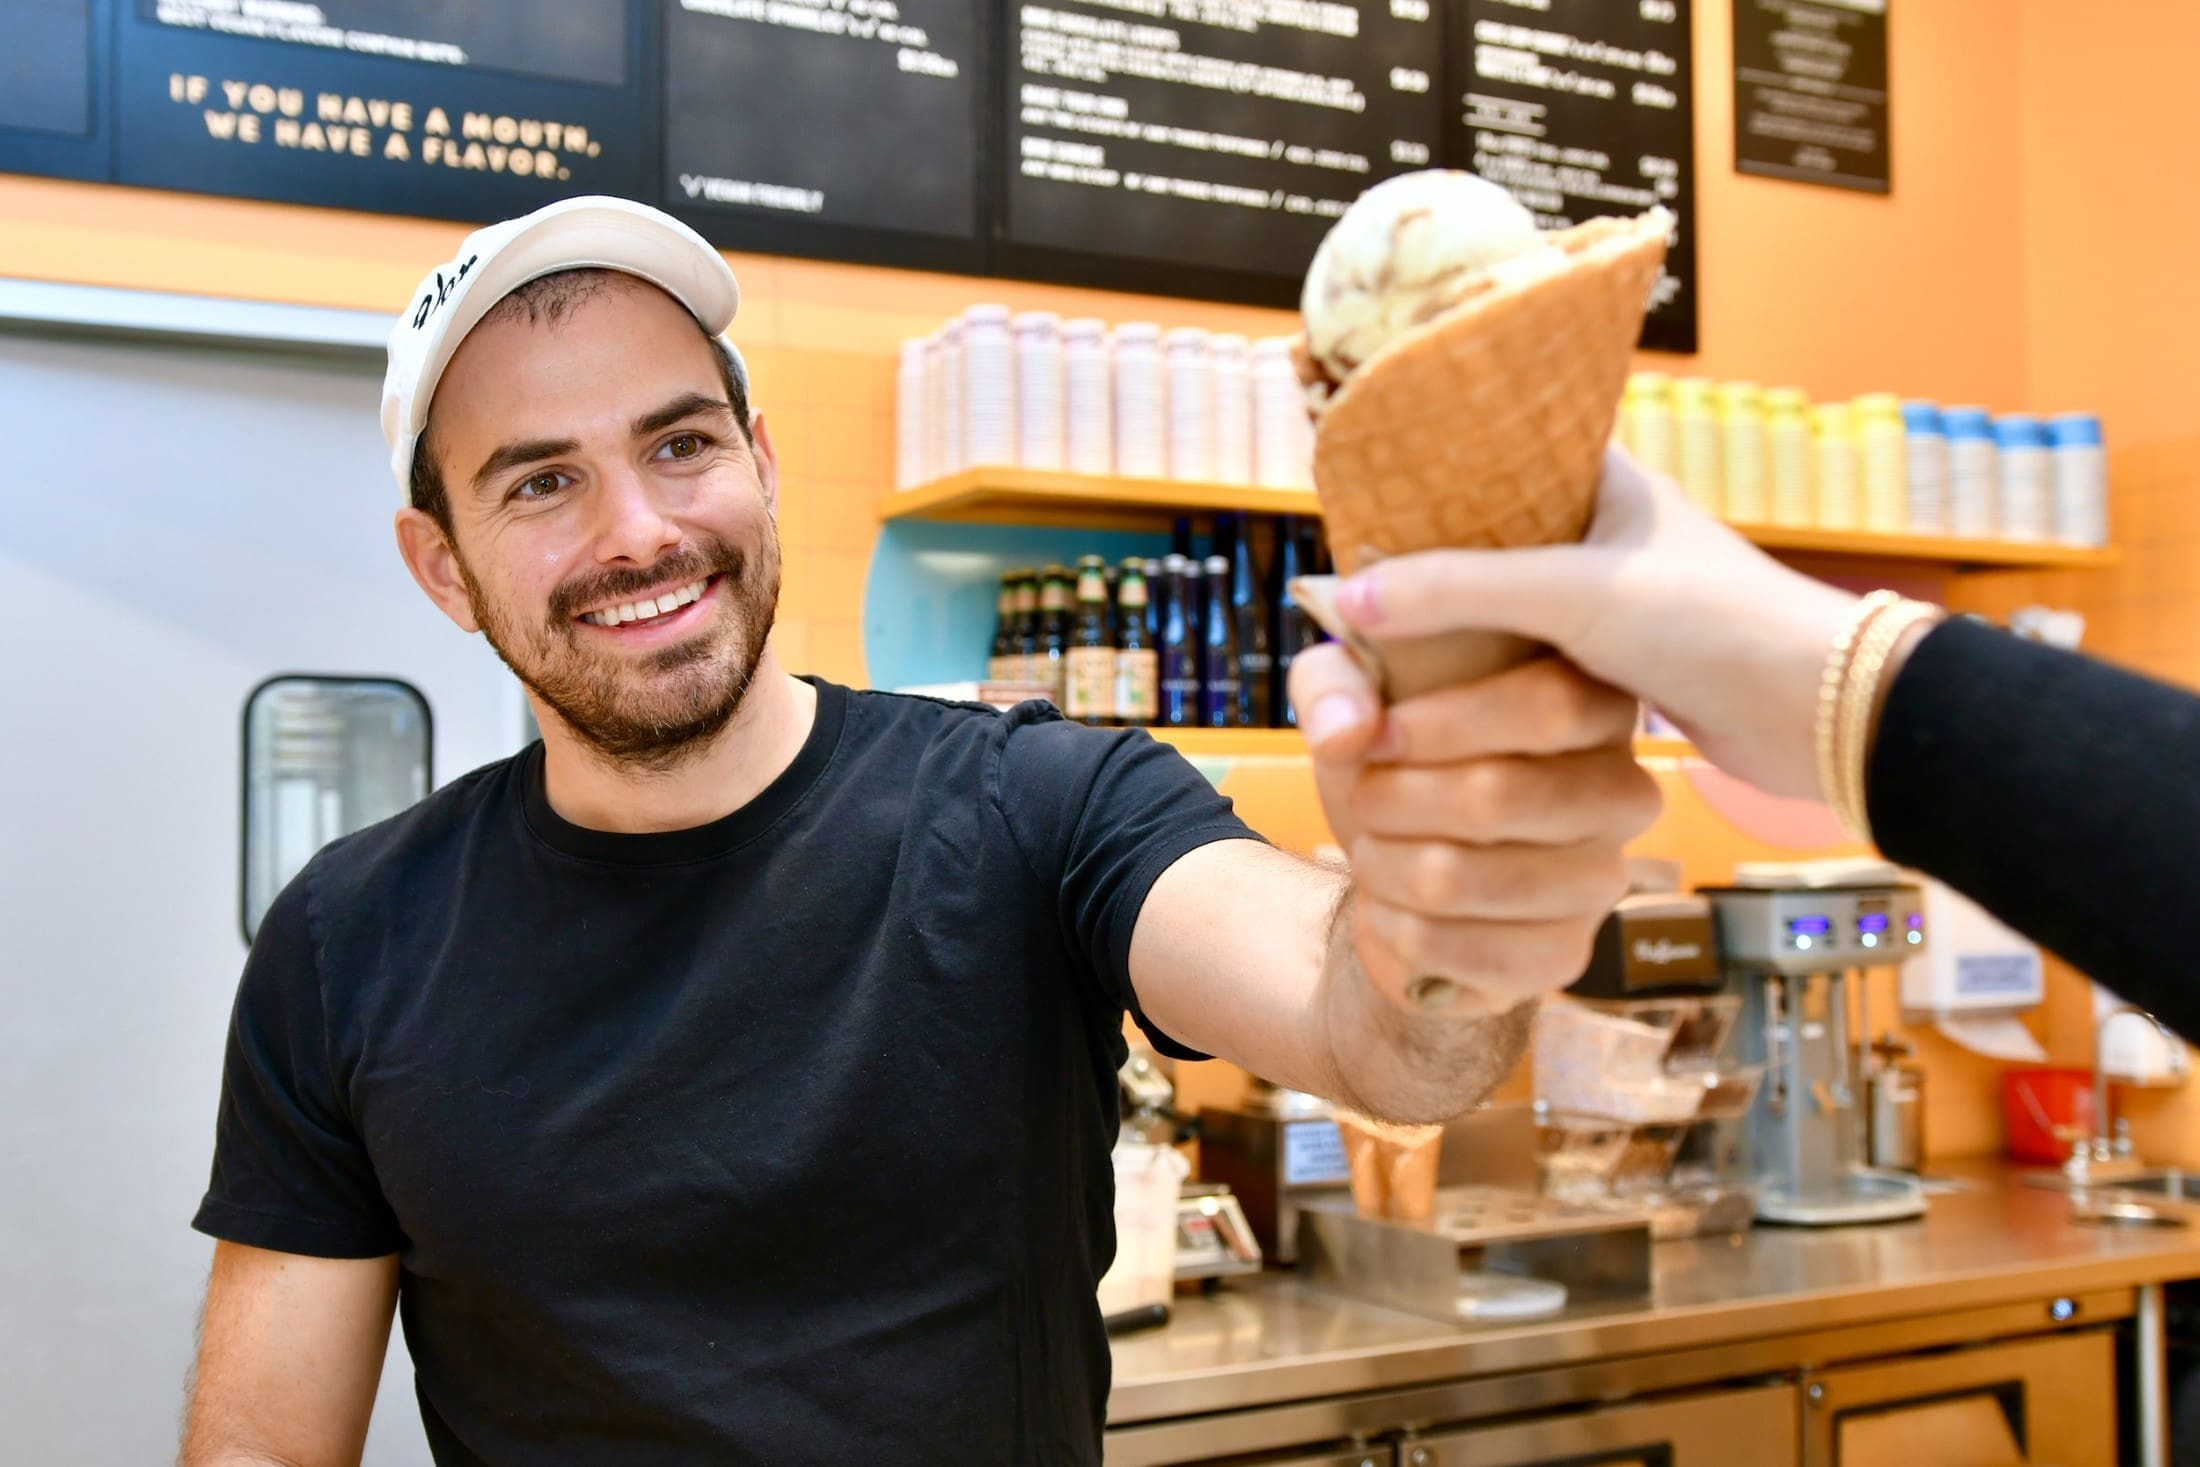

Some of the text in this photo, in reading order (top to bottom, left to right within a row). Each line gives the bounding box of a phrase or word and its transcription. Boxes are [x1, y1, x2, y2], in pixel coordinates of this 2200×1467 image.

[169, 73, 601, 158] IF YOU HAVE A MOUTH,
[204, 109, 571, 181] WE HAVE A FLAVOR.
